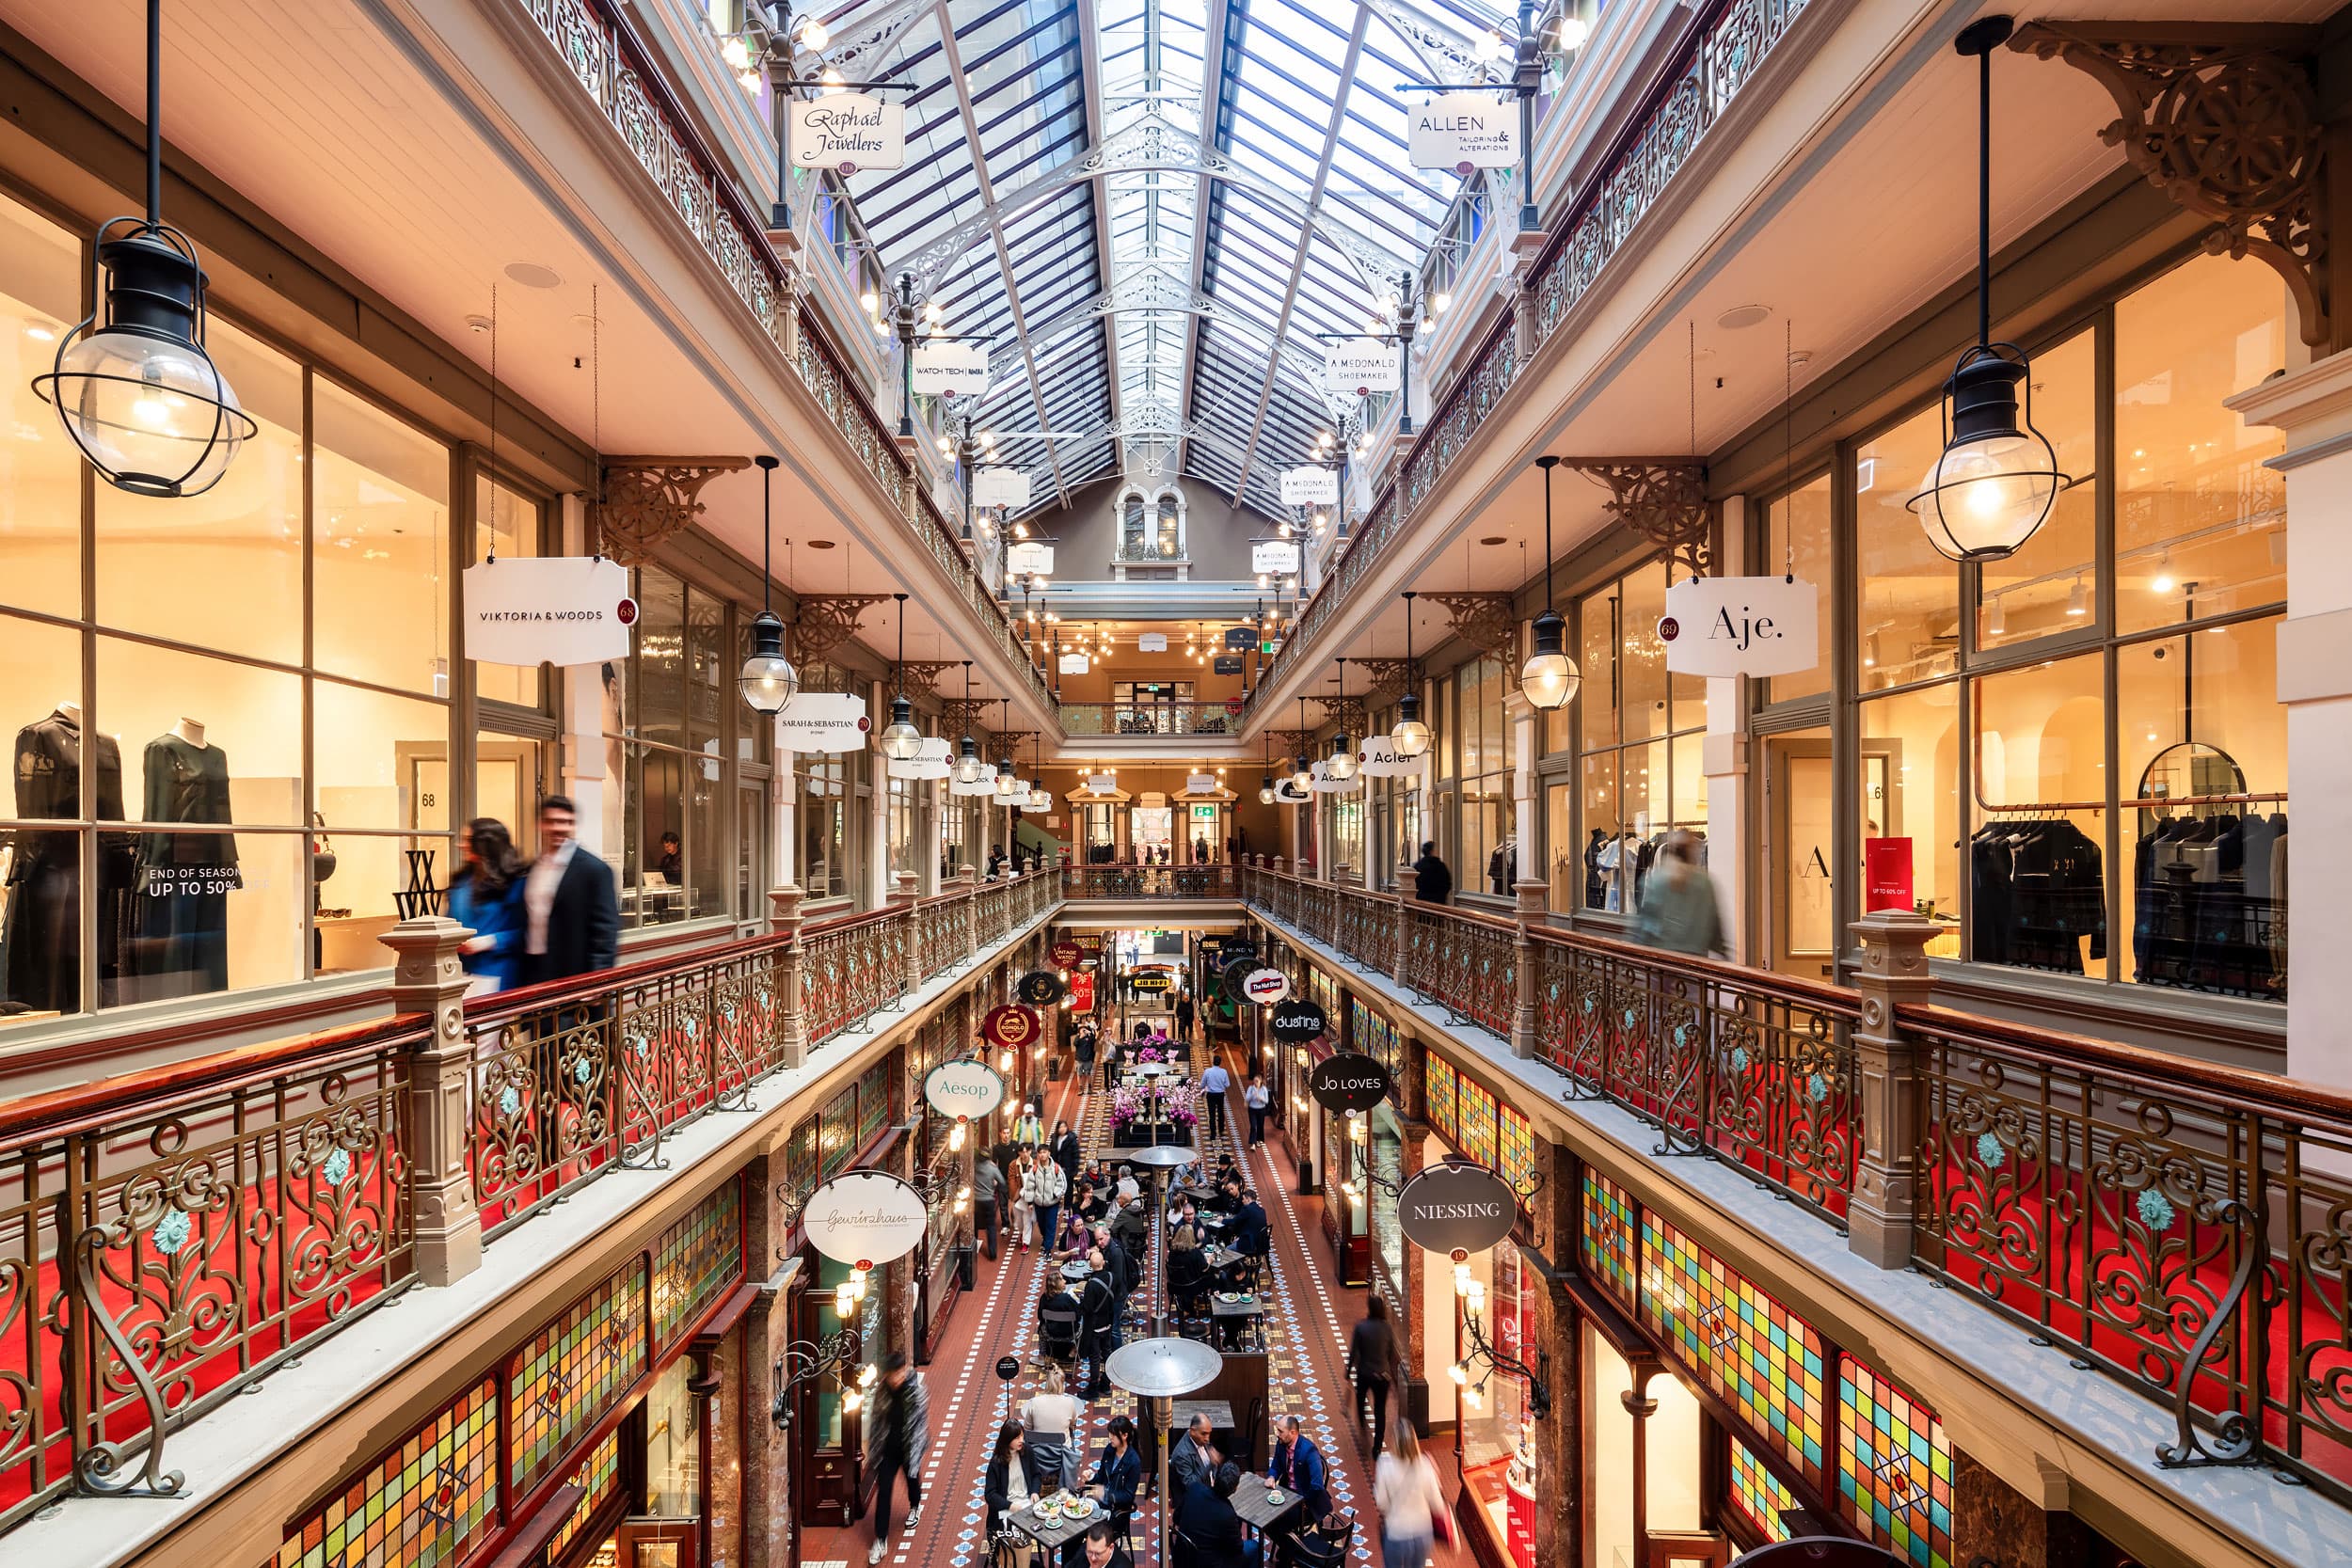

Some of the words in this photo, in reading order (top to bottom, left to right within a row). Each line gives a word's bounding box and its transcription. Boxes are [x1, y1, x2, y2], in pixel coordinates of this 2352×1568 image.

[804, 106, 882, 138] Raphaël
[1419, 117, 1484, 131] ALLEN
[803, 130, 883, 160] Jewellers
[1331, 358, 1337, 368] A
[916, 367, 943, 376] WATCH
[946, 367, 964, 375] TECH
[1338, 372, 1388, 380] SHOEMAKER
[480, 611, 542, 622] VIKTORIA
[545, 611, 552, 621] &
[554, 610, 603, 621] WOODS
[620, 607, 634, 617] 68
[1661, 624, 1677, 636] 69
[1708, 604, 1783, 651] Aje.
[814, 720, 854, 728] SEBASTIAN
[859, 720, 868, 728] 70
[421, 793, 436, 807] 68
[150, 868, 175, 879] END
[179, 868, 195, 879] OF
[199, 867, 243, 878] SEASON
[150, 882, 173, 896] UP
[179, 881, 200, 895] TO
[206, 880, 237, 895] 50%
[1054, 946, 1077, 956] VINTAGE
[1276, 1016, 1321, 1028] dustins
[1319, 1075, 1338, 1091] Jo
[1341, 1078, 1381, 1089] LOVES
[939, 1081, 989, 1100] Aesop
[1414, 1202, 1501, 1220] NIESSING
[1454, 1251, 1465, 1260] 19
